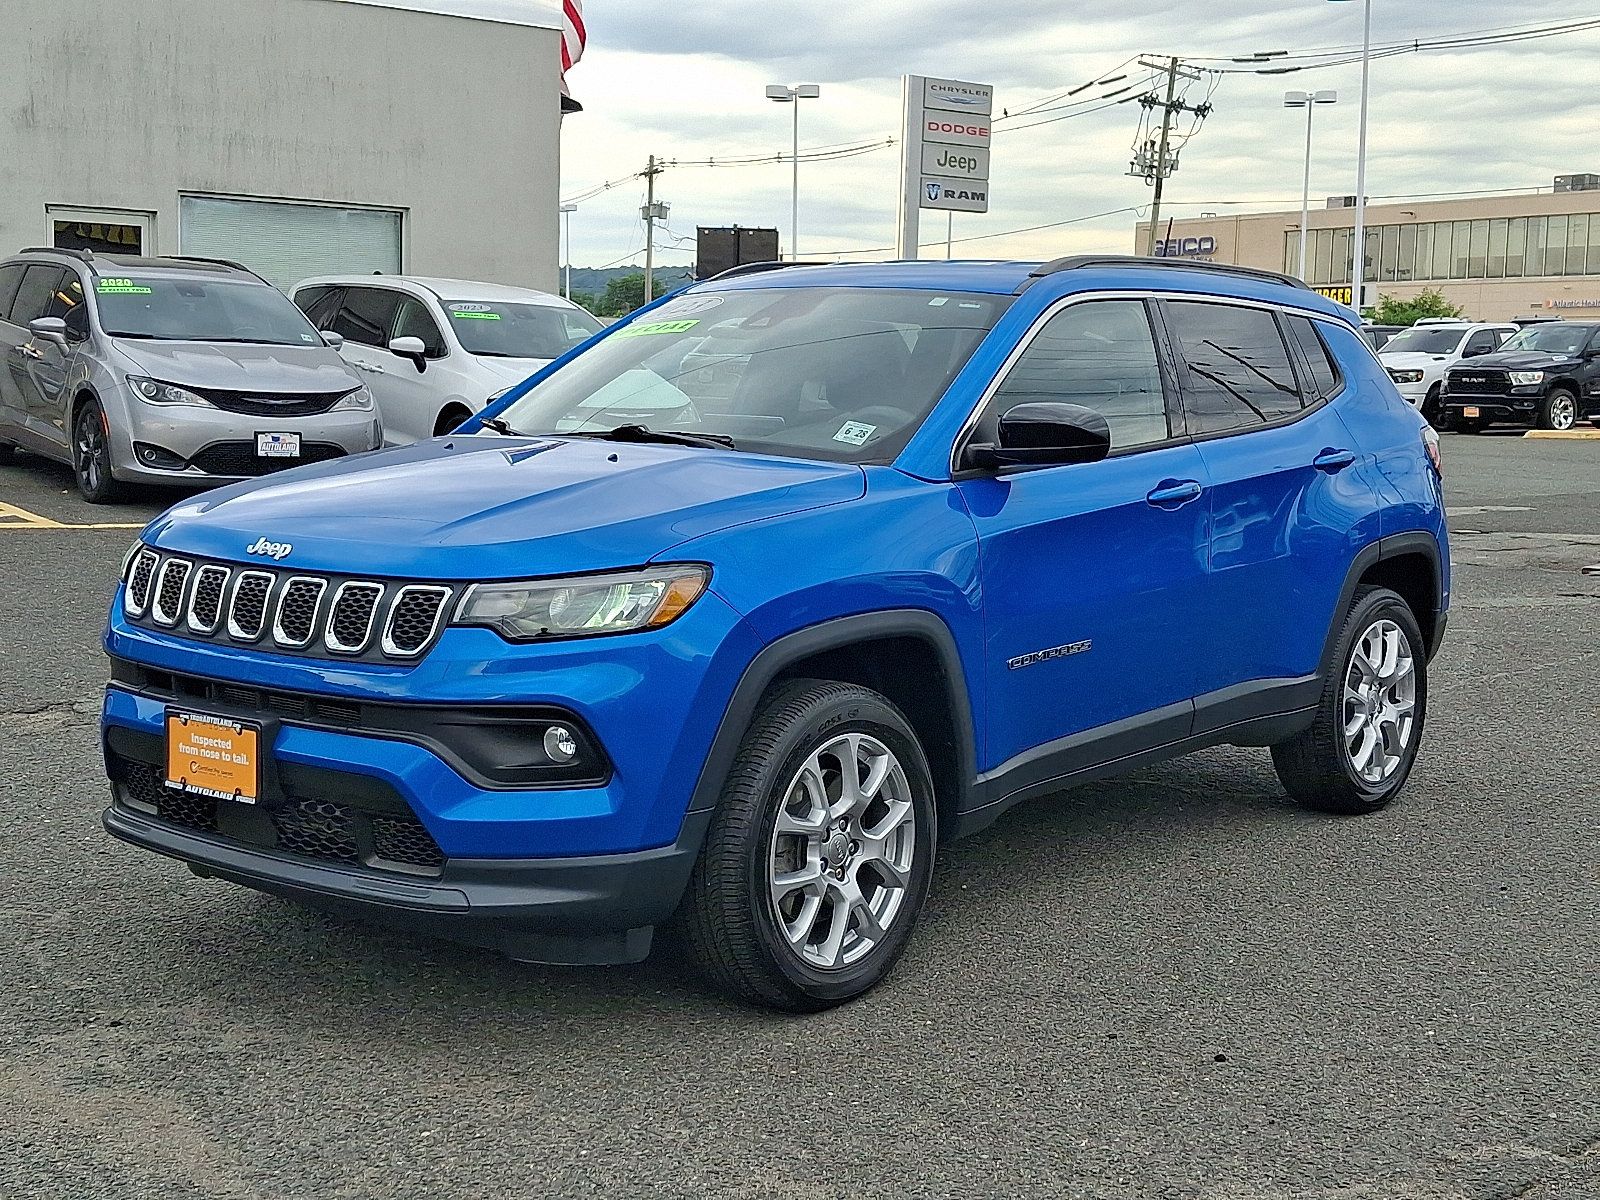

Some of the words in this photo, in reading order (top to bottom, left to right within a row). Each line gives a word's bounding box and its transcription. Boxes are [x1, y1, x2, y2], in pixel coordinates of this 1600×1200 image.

[930, 84, 989, 97] CHRYSLER
[927, 121, 989, 137] DODGE
[936, 149, 978, 173] Jeep
[943, 189, 986, 201] RAM
[100, 278, 133, 287] 2020
[844, 427, 853, 435] 6
[260, 442, 297, 452] AUTOLAND
[246, 536, 293, 561] Jeep
[1006, 639, 1092, 670] COMPASS
[191, 733, 232, 750] Inspected
[178, 742, 199, 756] from
[200, 748, 220, 760] nose
[221, 750, 231, 762] to
[232, 752, 250, 766] tail.
[184, 784, 234, 801] AUTOLAND
